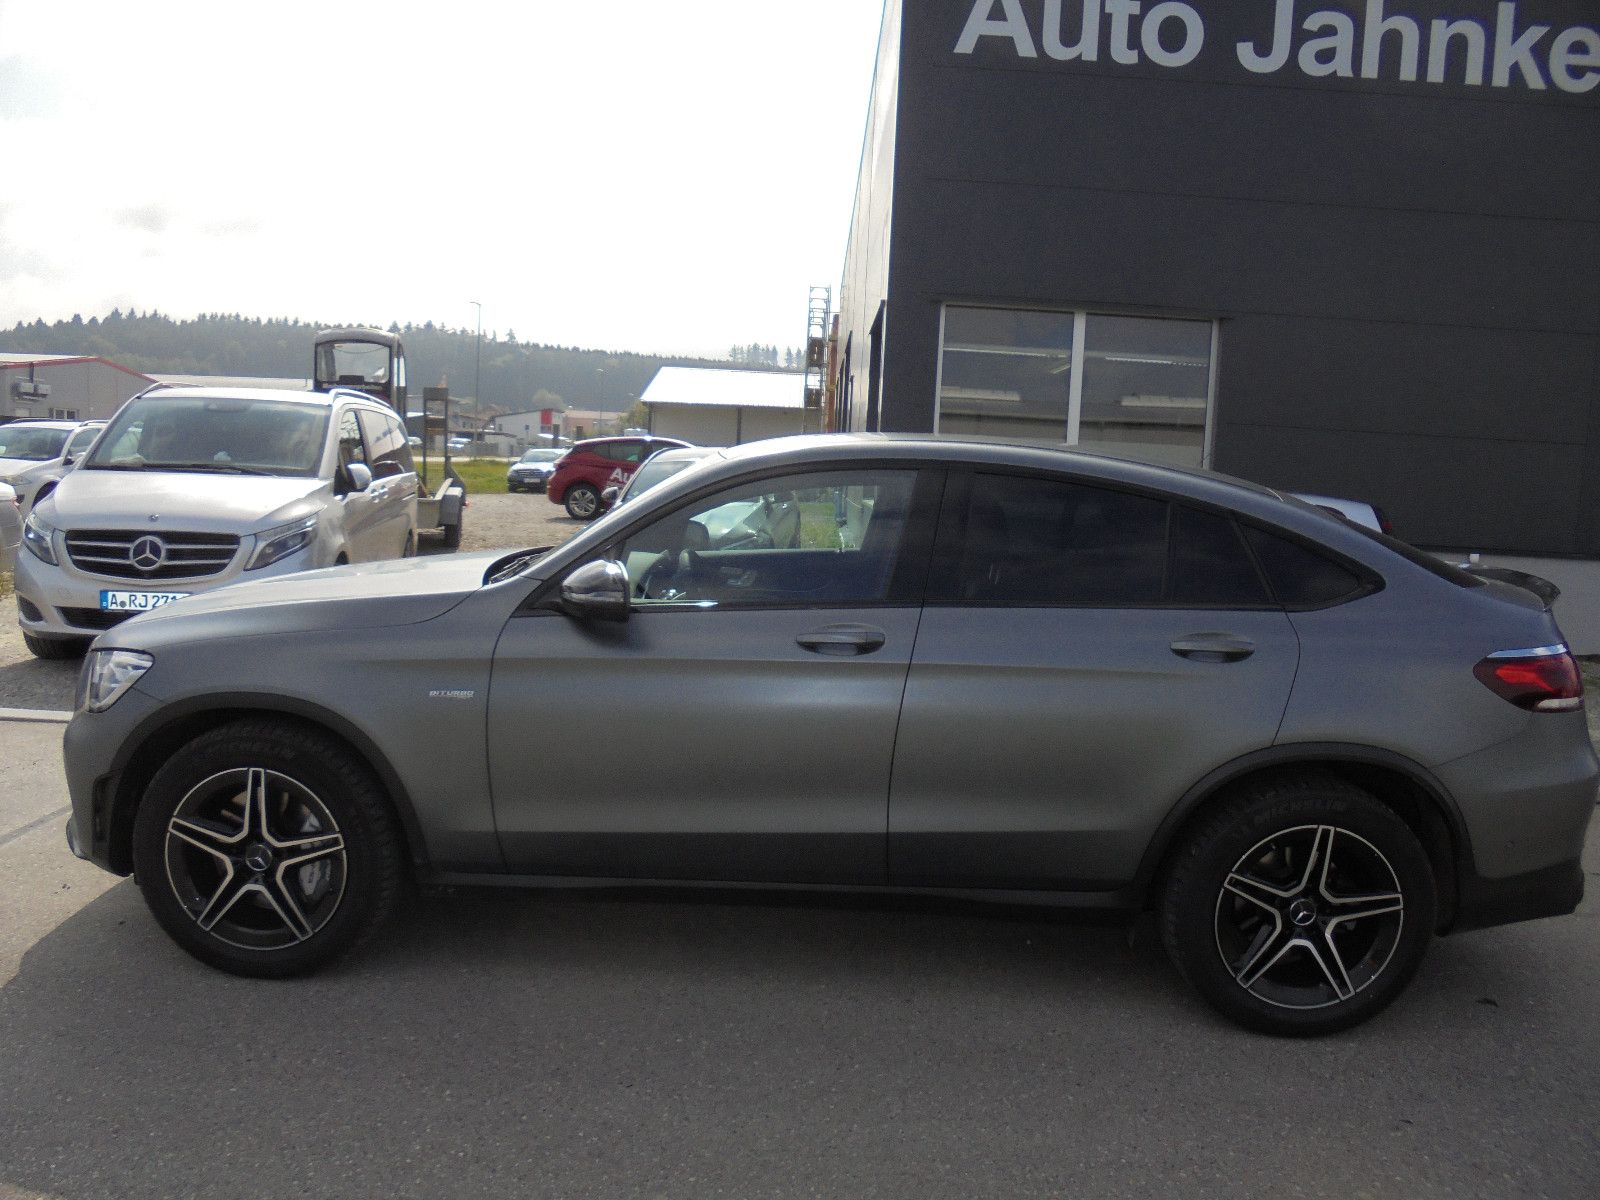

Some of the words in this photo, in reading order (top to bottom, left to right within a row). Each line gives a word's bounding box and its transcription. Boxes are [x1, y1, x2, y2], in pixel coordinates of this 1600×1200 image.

[953, 0, 1205, 67] Auto
[1236, 0, 1600, 93] Jahnke
[110, 594, 118, 607] A
